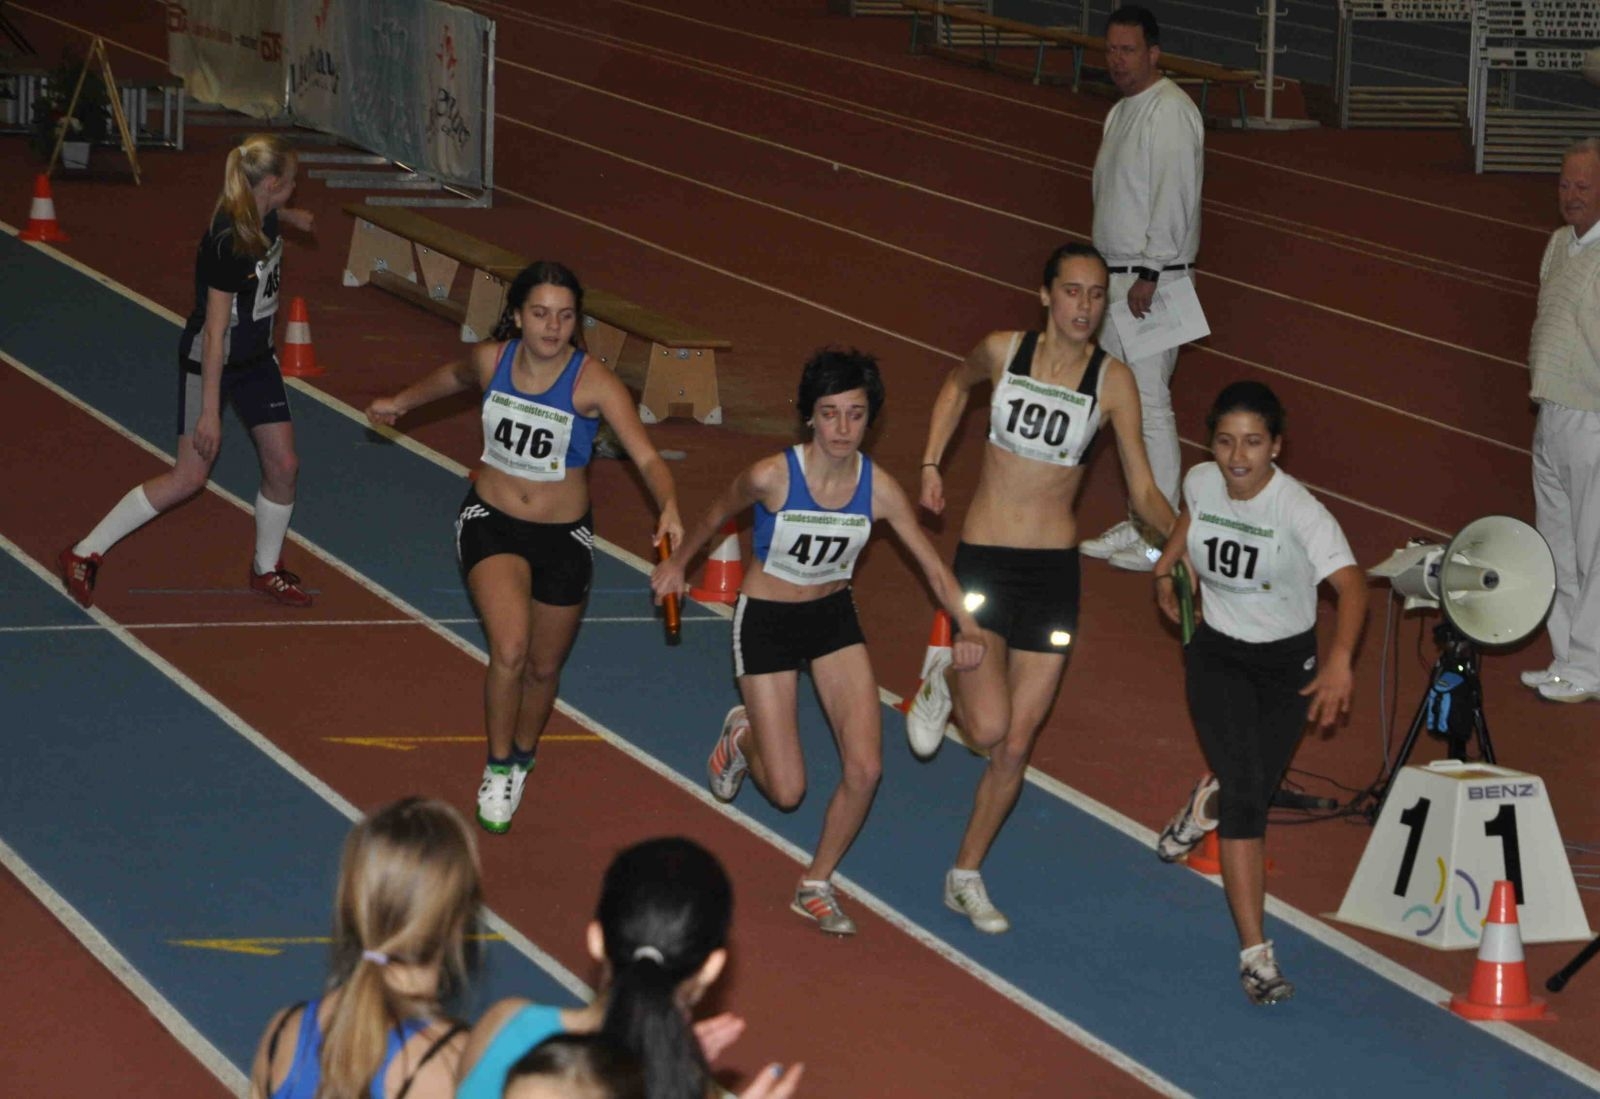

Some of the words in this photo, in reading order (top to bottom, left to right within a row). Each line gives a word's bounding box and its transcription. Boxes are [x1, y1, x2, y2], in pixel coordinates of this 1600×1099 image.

[1395, 11, 1469, 19] CHEMNITZ
[1007, 376, 1086, 406] Landesmeisterschaft
[492, 394, 568, 425] Landesmeisterschaft
[1006, 398, 1070, 447] 190
[494, 417, 554, 459] 476
[783, 514, 866, 526] Landesmeisterschaft
[788, 533, 850, 567] 477
[1203, 536, 1259, 579] 197
[1467, 784, 1534, 801] BENZ
[1393, 796, 1431, 898] 1
[1484, 803, 1525, 905] 1
